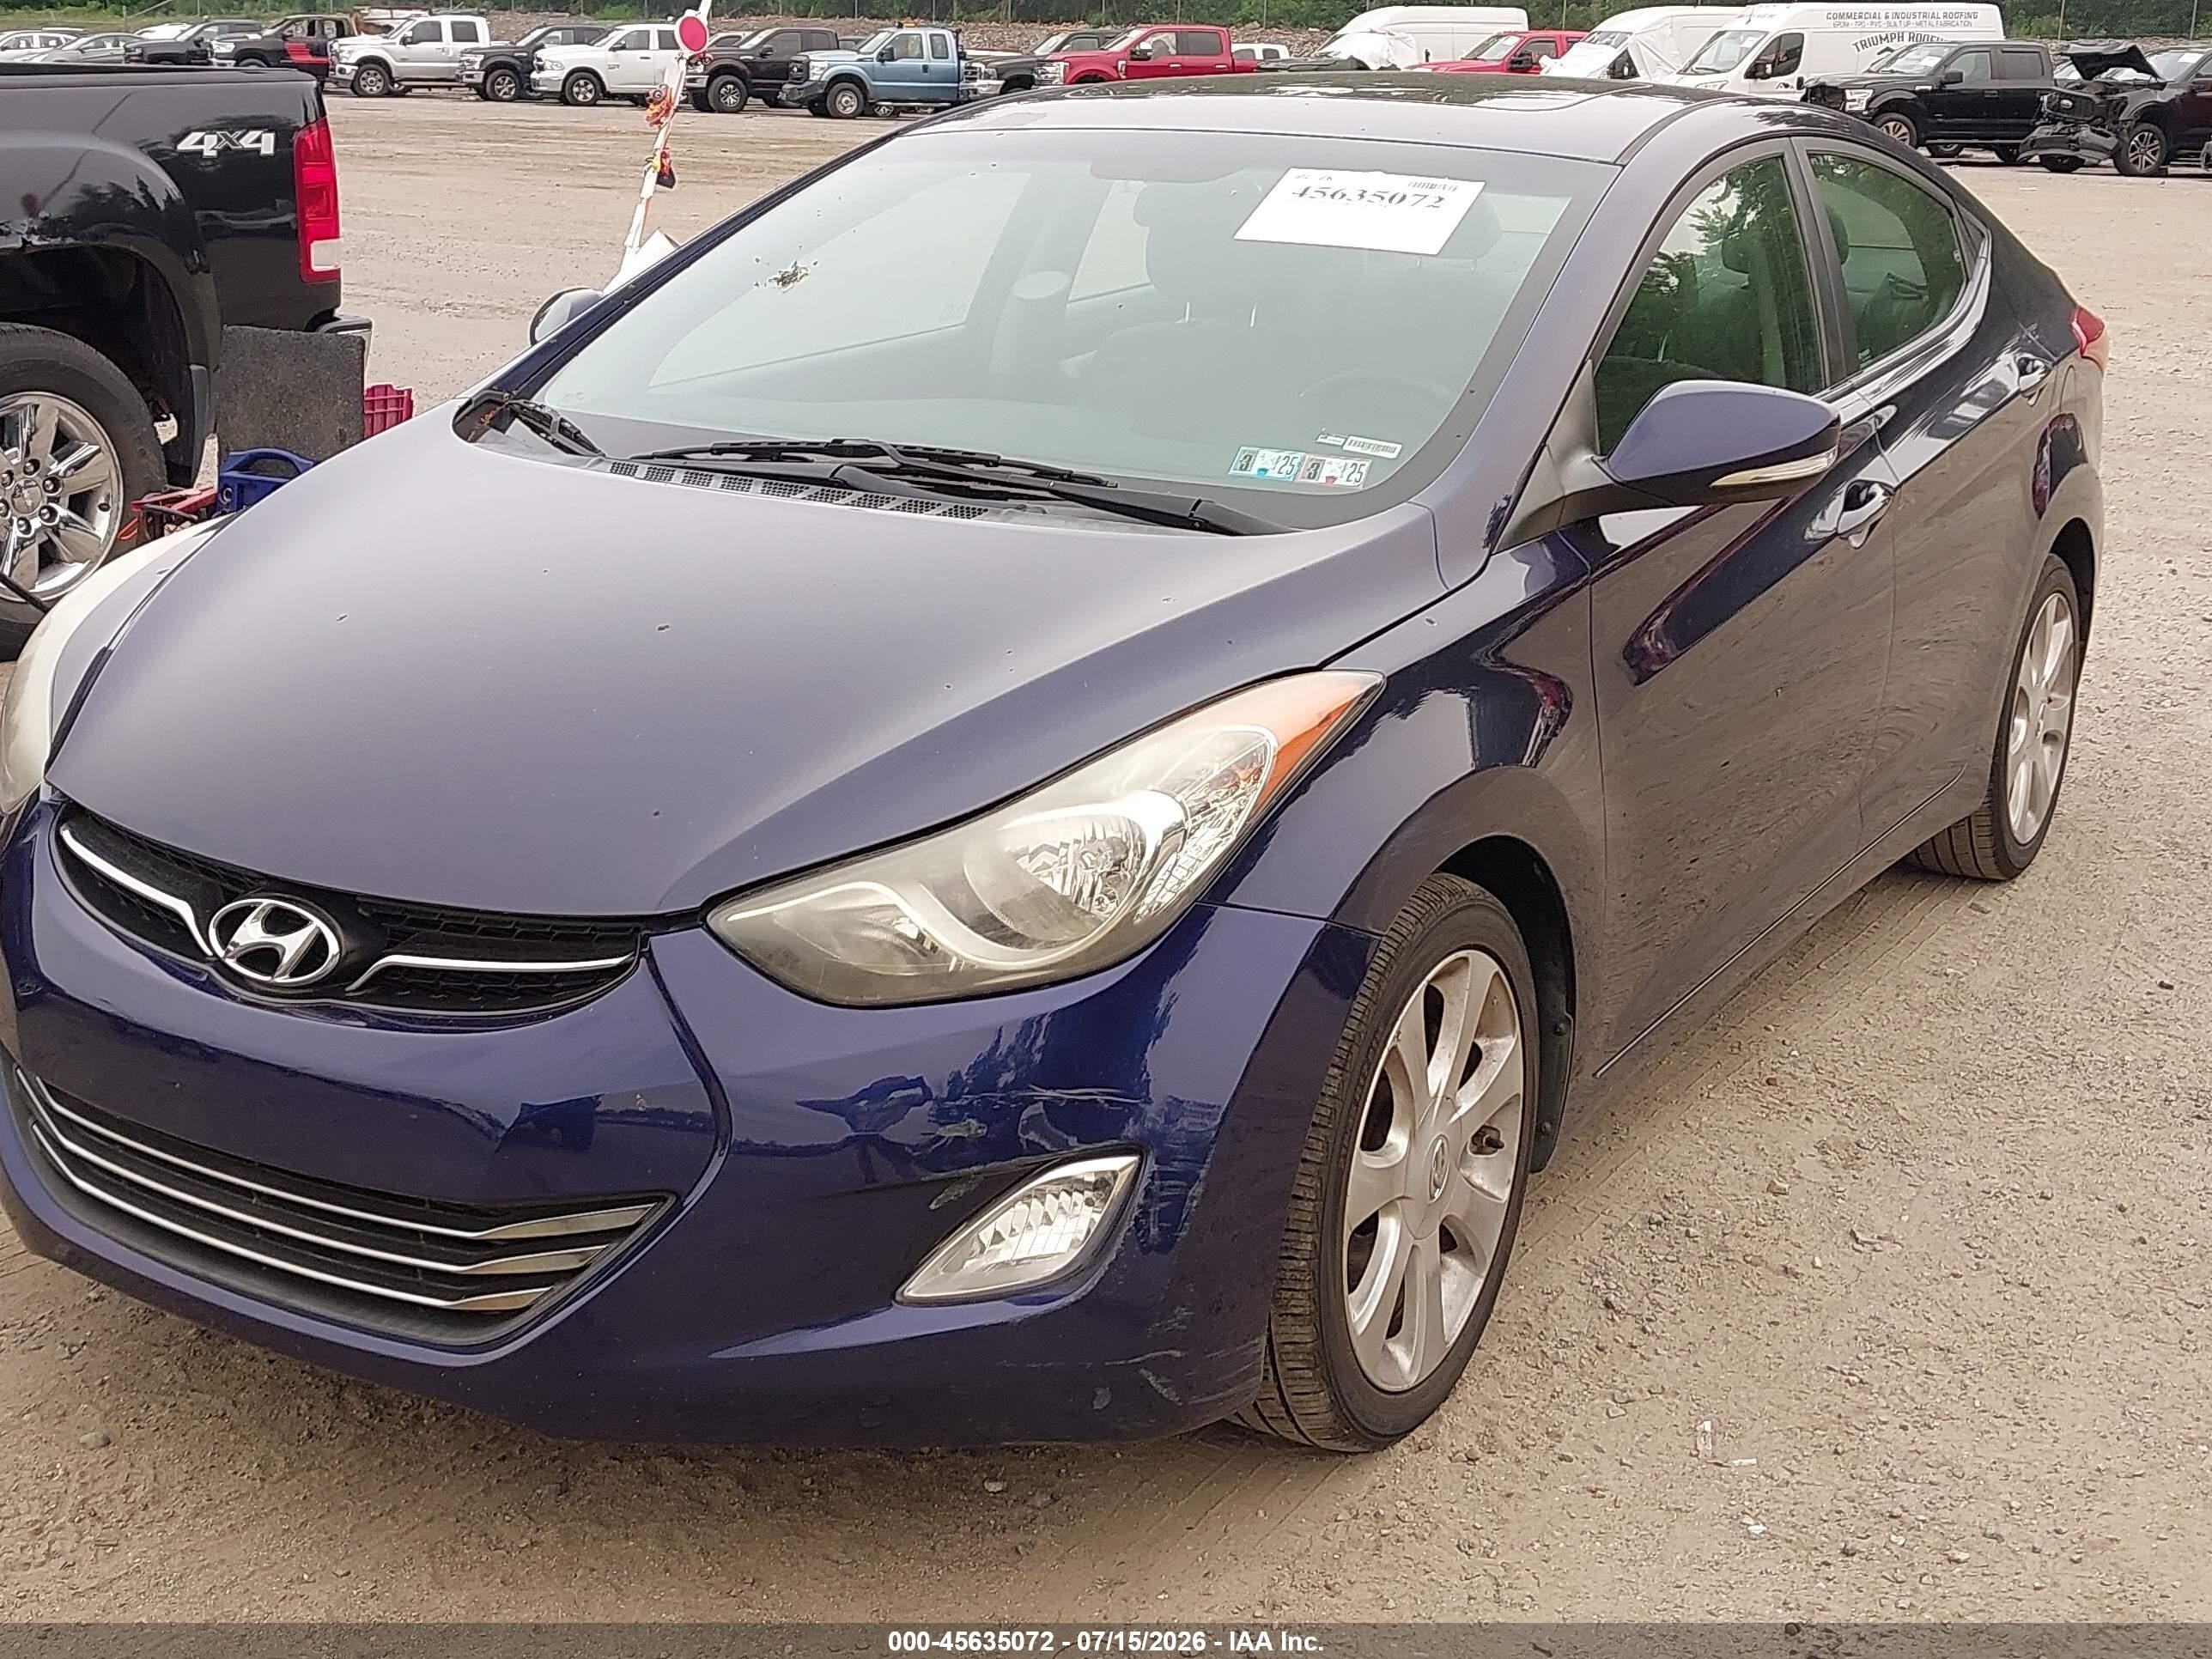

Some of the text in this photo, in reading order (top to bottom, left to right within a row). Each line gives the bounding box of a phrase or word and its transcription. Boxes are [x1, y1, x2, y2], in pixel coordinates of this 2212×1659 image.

[1852, 32, 1905, 52] TRIUMPH
[1291, 185, 1445, 209] 45635072
[1238, 453, 1298, 475] 3 25
[1306, 462, 1365, 483] 3 25
